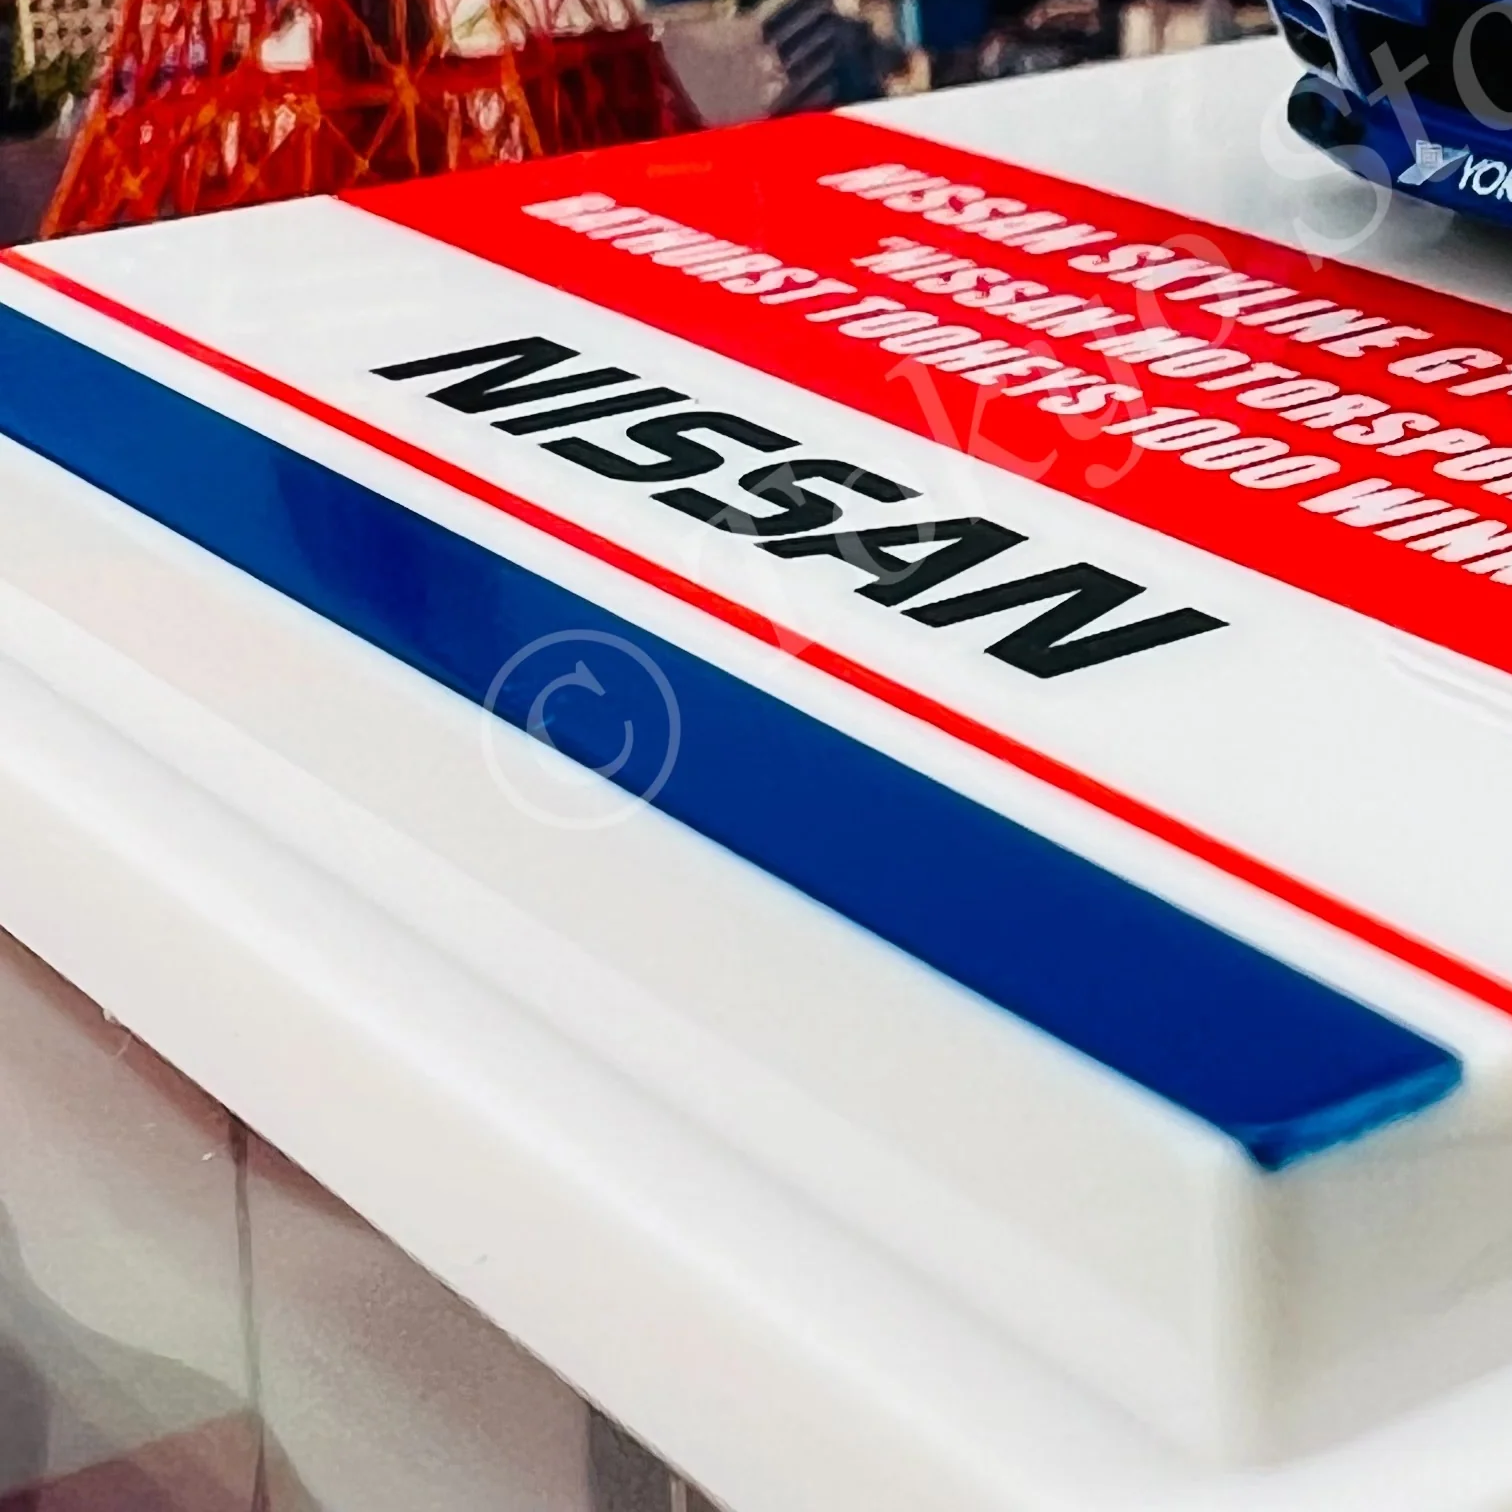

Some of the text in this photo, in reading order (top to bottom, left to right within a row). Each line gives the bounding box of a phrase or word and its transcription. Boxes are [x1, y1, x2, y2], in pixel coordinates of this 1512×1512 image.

[818, 163, 1117, 255] NISSAN
[1067, 243, 1434, 358] SKYLINE
[804, 295, 1144, 416] TOOHEYS
[1100, 406, 1342, 491] 1000
[368, 335, 1231, 679] NISSAN
